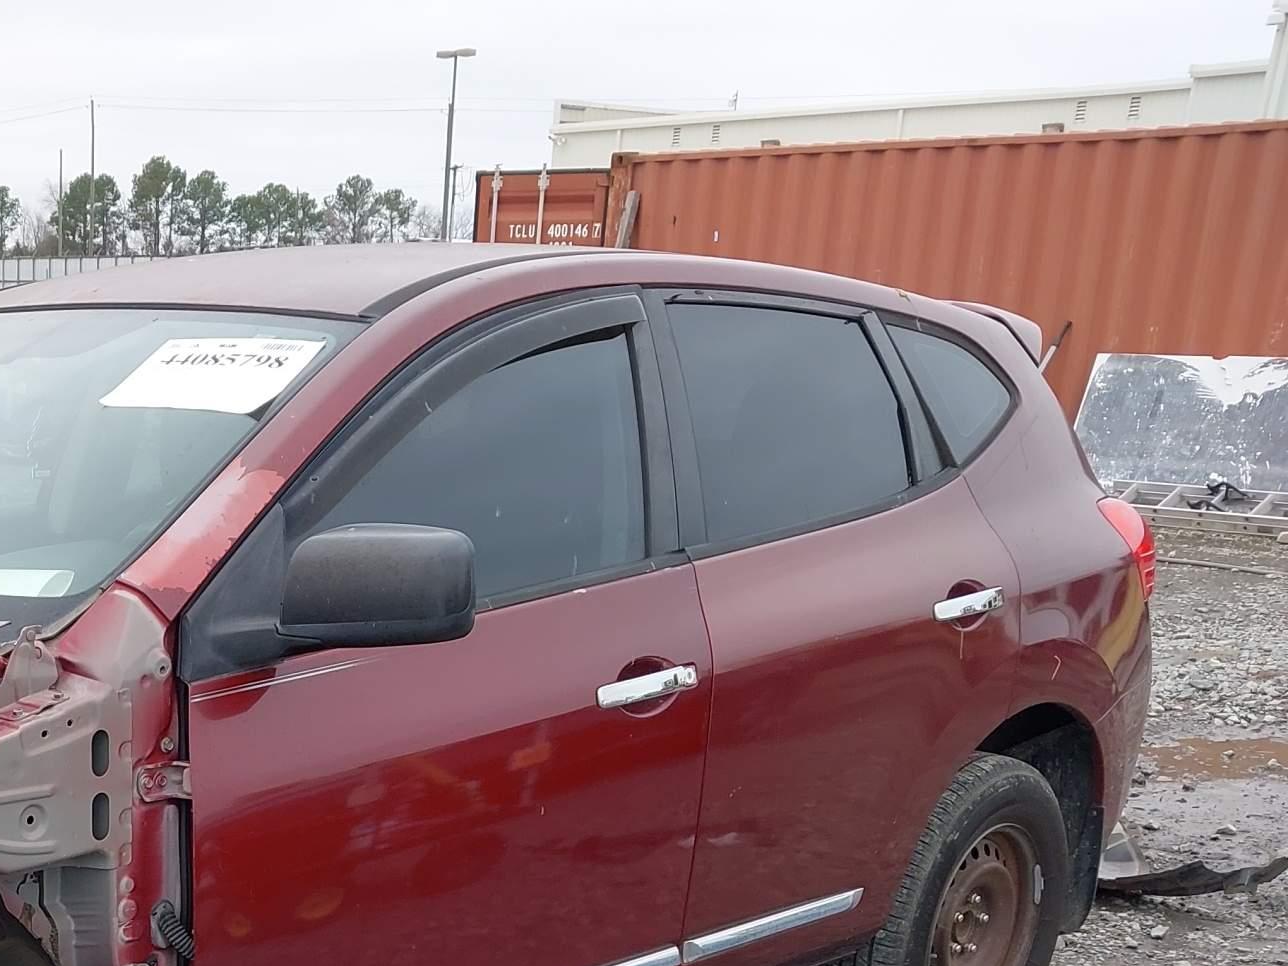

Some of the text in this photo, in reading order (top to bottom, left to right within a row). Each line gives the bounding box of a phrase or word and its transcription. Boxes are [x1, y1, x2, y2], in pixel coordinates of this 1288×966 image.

[509, 222, 602, 239] TCLU 400146 7
[160, 353, 289, 369] 44085798
